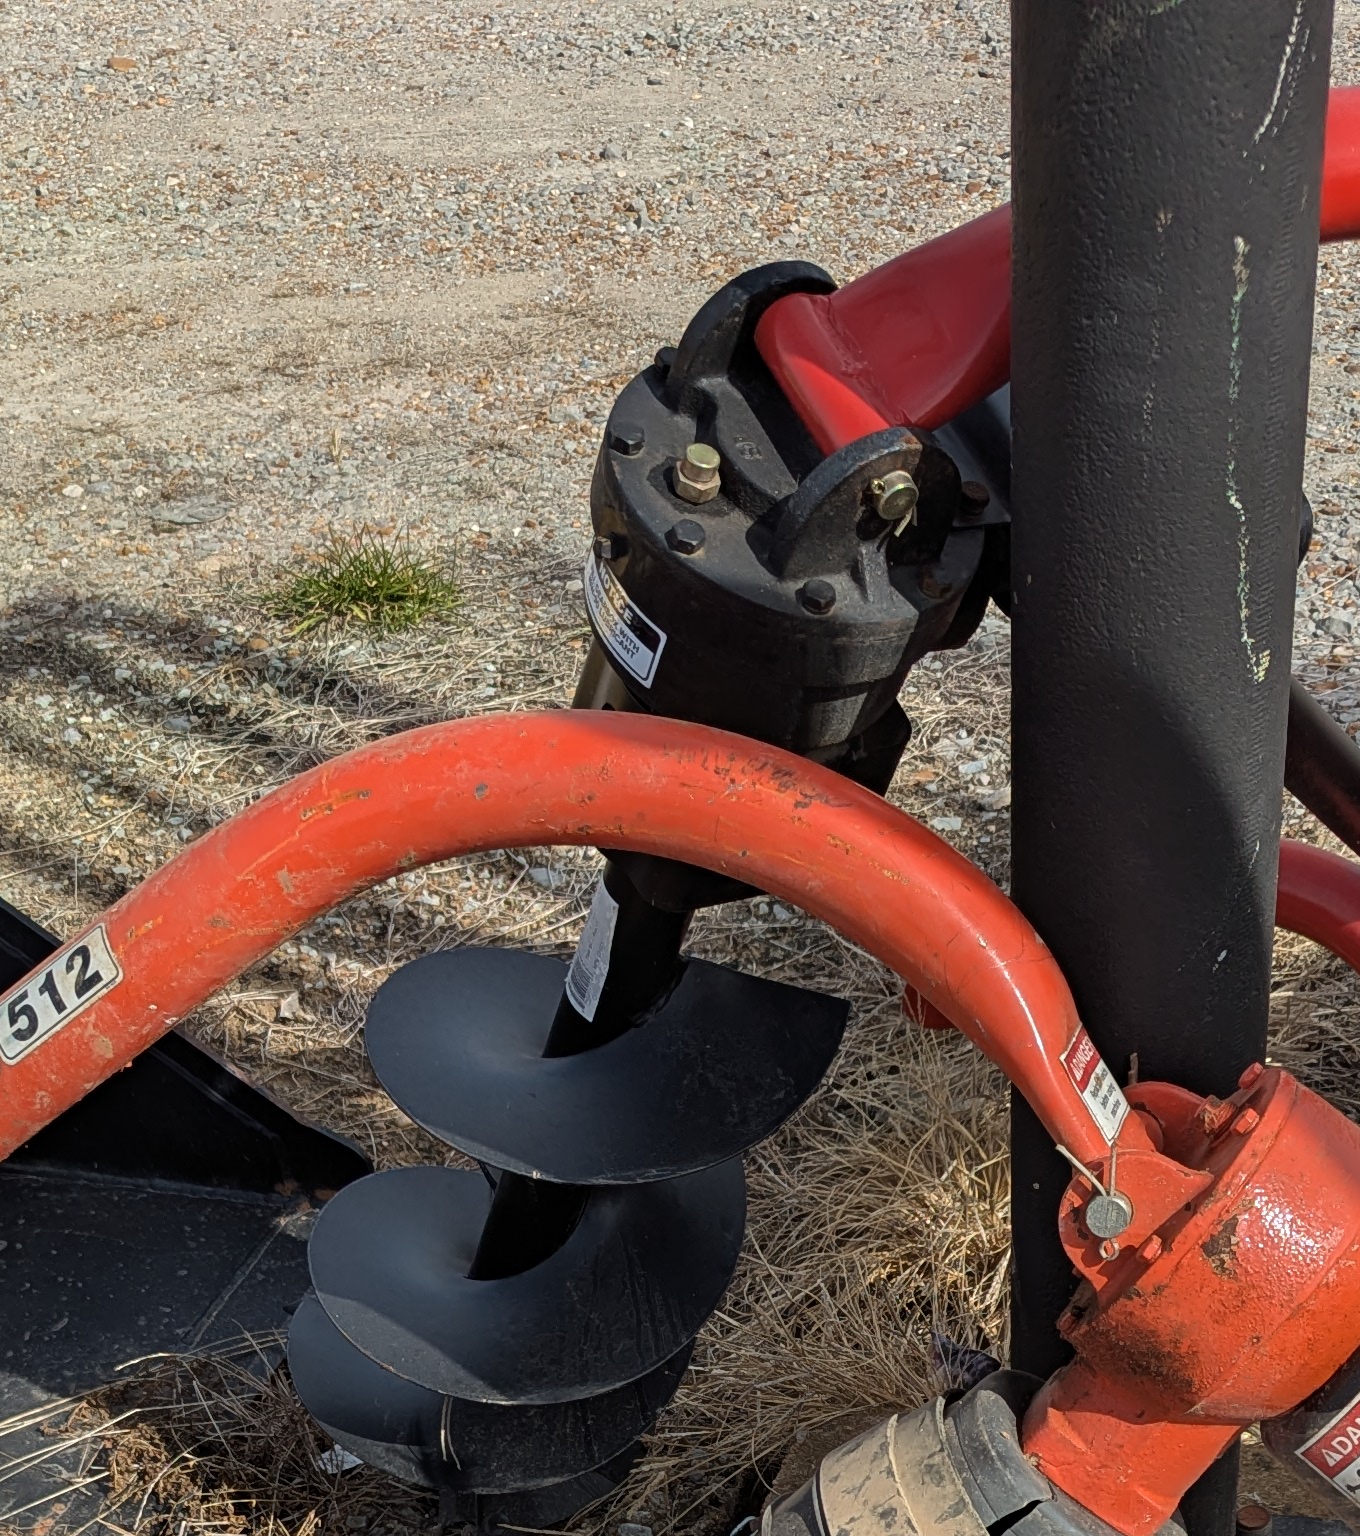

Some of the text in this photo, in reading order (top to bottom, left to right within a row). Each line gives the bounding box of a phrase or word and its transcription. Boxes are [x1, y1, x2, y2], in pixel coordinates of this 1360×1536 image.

[599, 560, 633, 625] NOTICE
[619, 627, 640, 653] WITH
[4, 943, 103, 1042] 512
